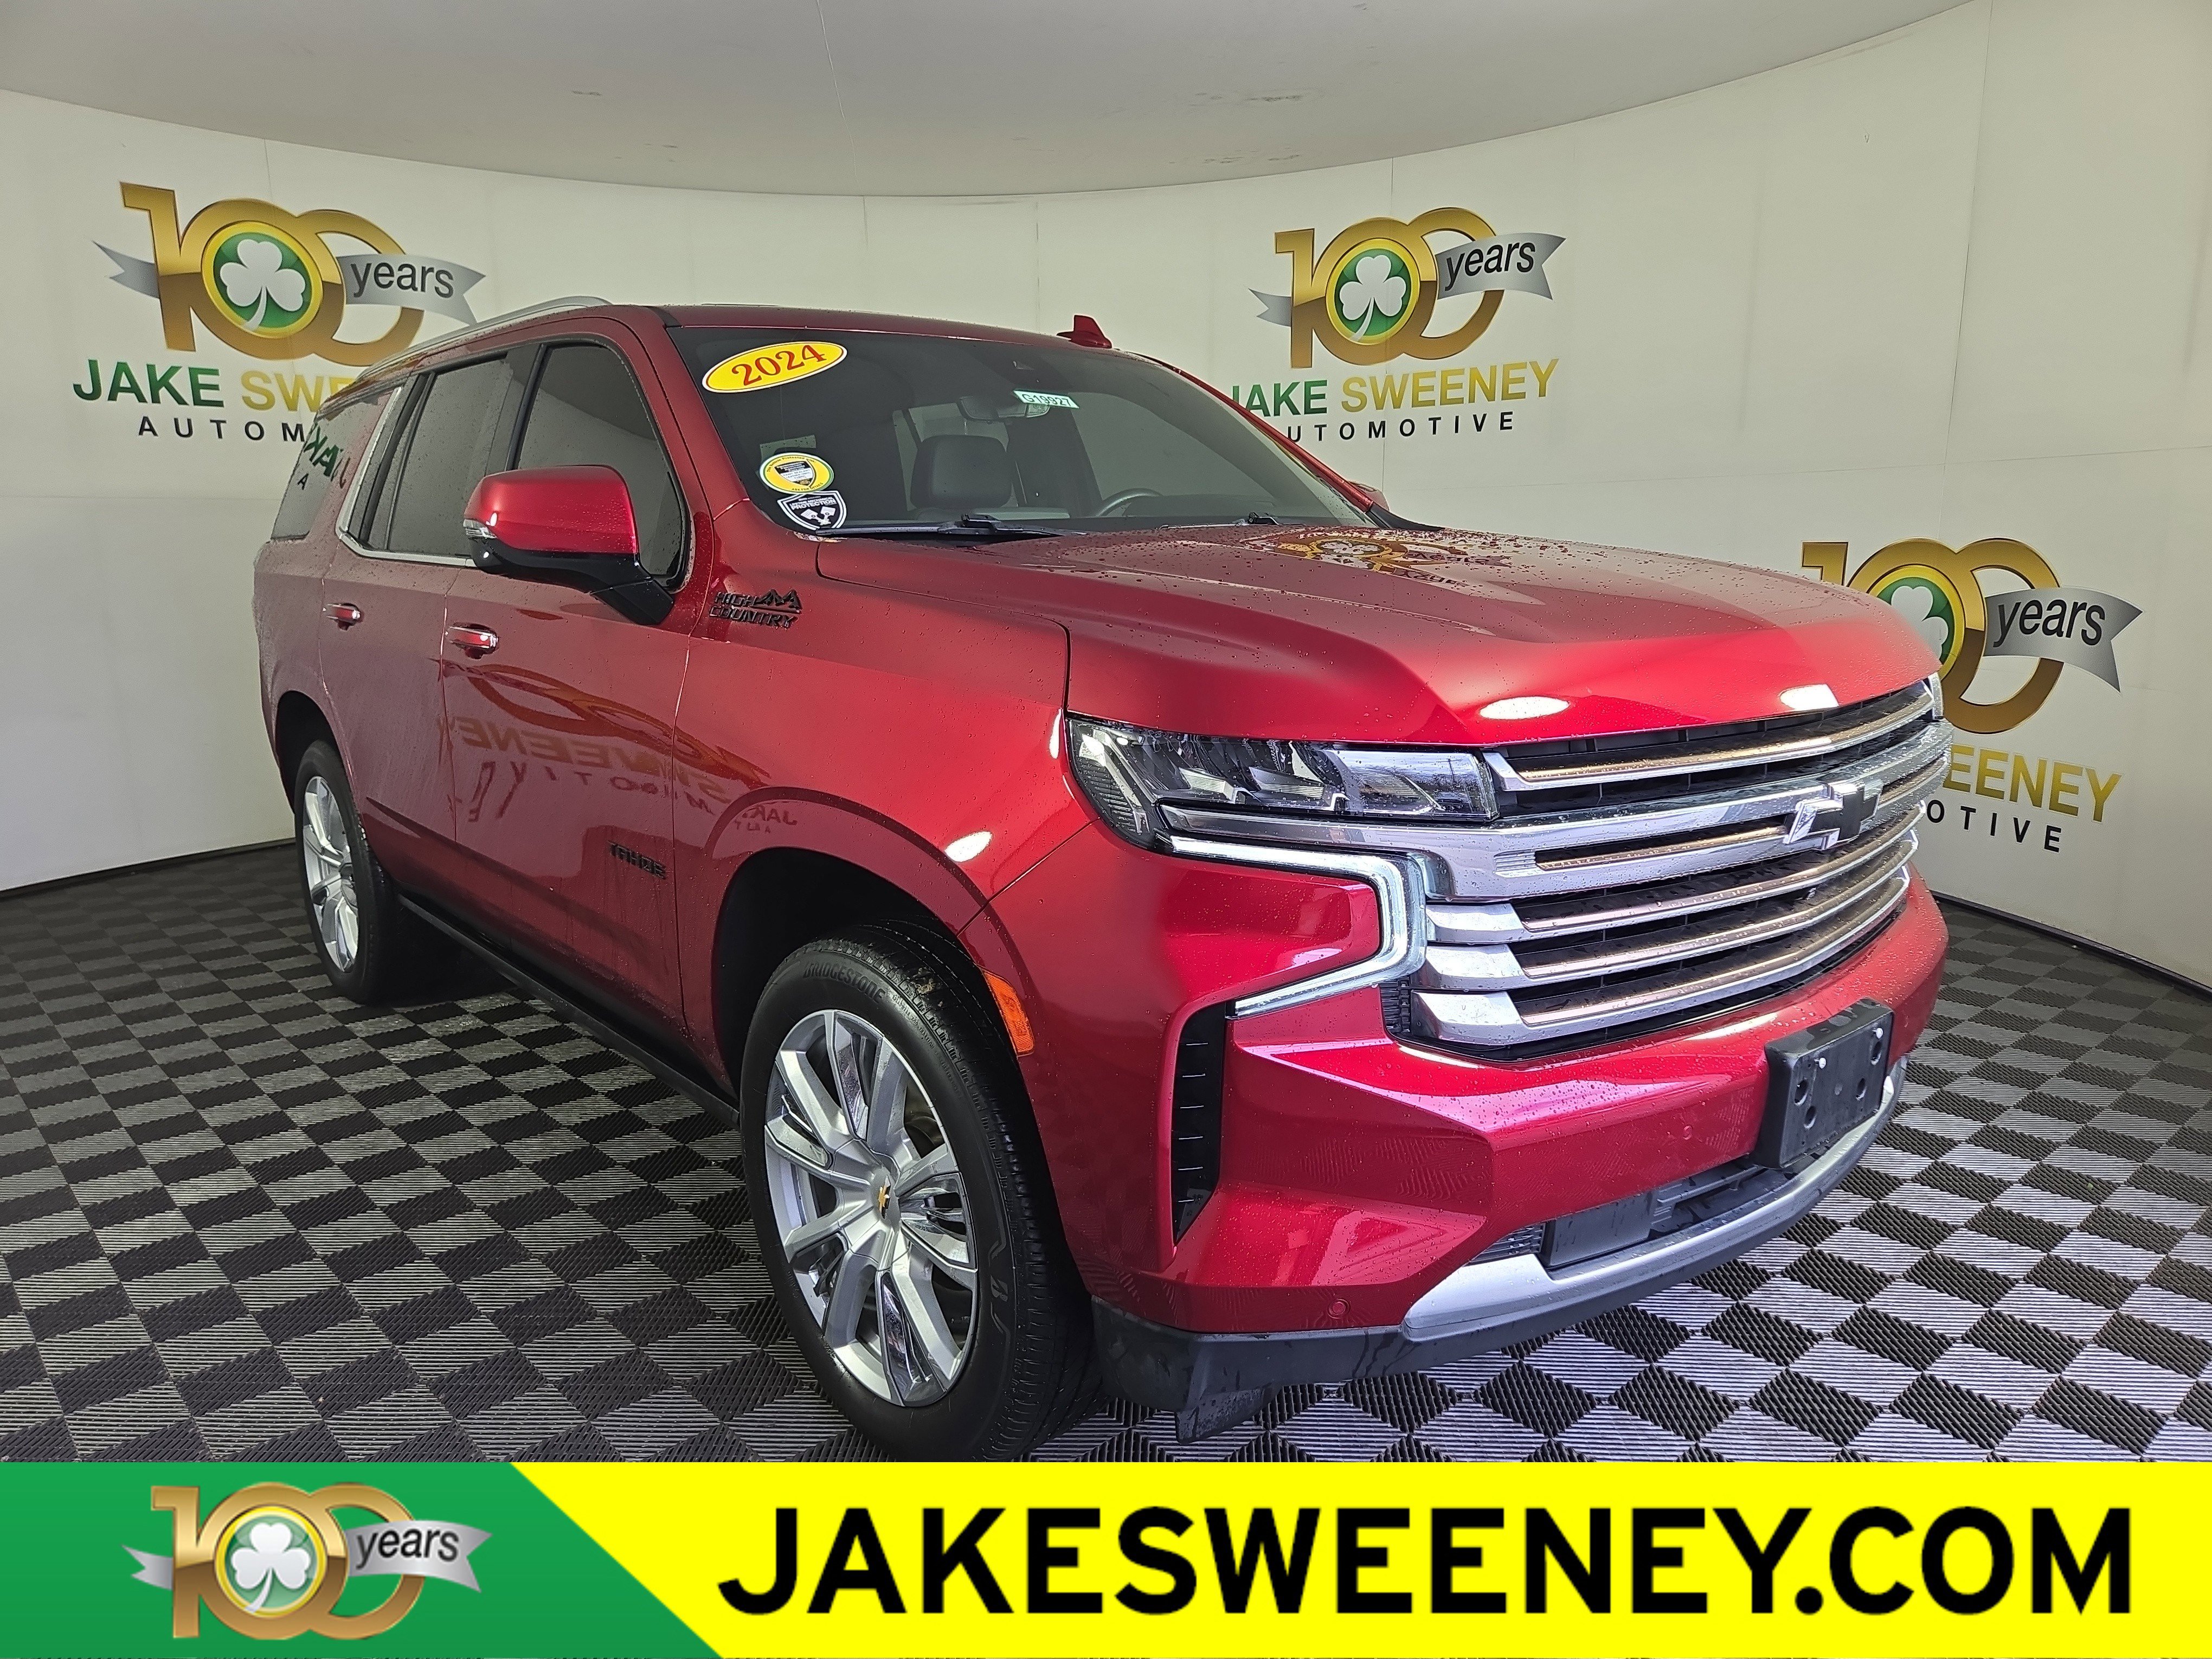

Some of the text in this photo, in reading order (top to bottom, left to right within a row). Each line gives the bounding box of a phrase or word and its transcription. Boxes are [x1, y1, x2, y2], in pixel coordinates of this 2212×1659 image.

[351, 260, 454, 299] years
[1444, 241, 1536, 292] years
[73, 358, 224, 408] JAKE
[731, 344, 827, 386] 2024
[1341, 358, 1559, 413] SWEENEY
[1021, 394, 1071, 407] G19927
[138, 416, 305, 443] AUTOM
[790, 498, 837, 510] PROTECTION
[709, 605, 799, 628] COUNTRY
[715, 591, 758, 607] HIGH
[1993, 599, 2106, 648] years
[1926, 799, 2062, 853] OTIVE
[608, 840, 667, 880] TAHOE
[803, 962, 885, 1004] BRIDGESTONE
